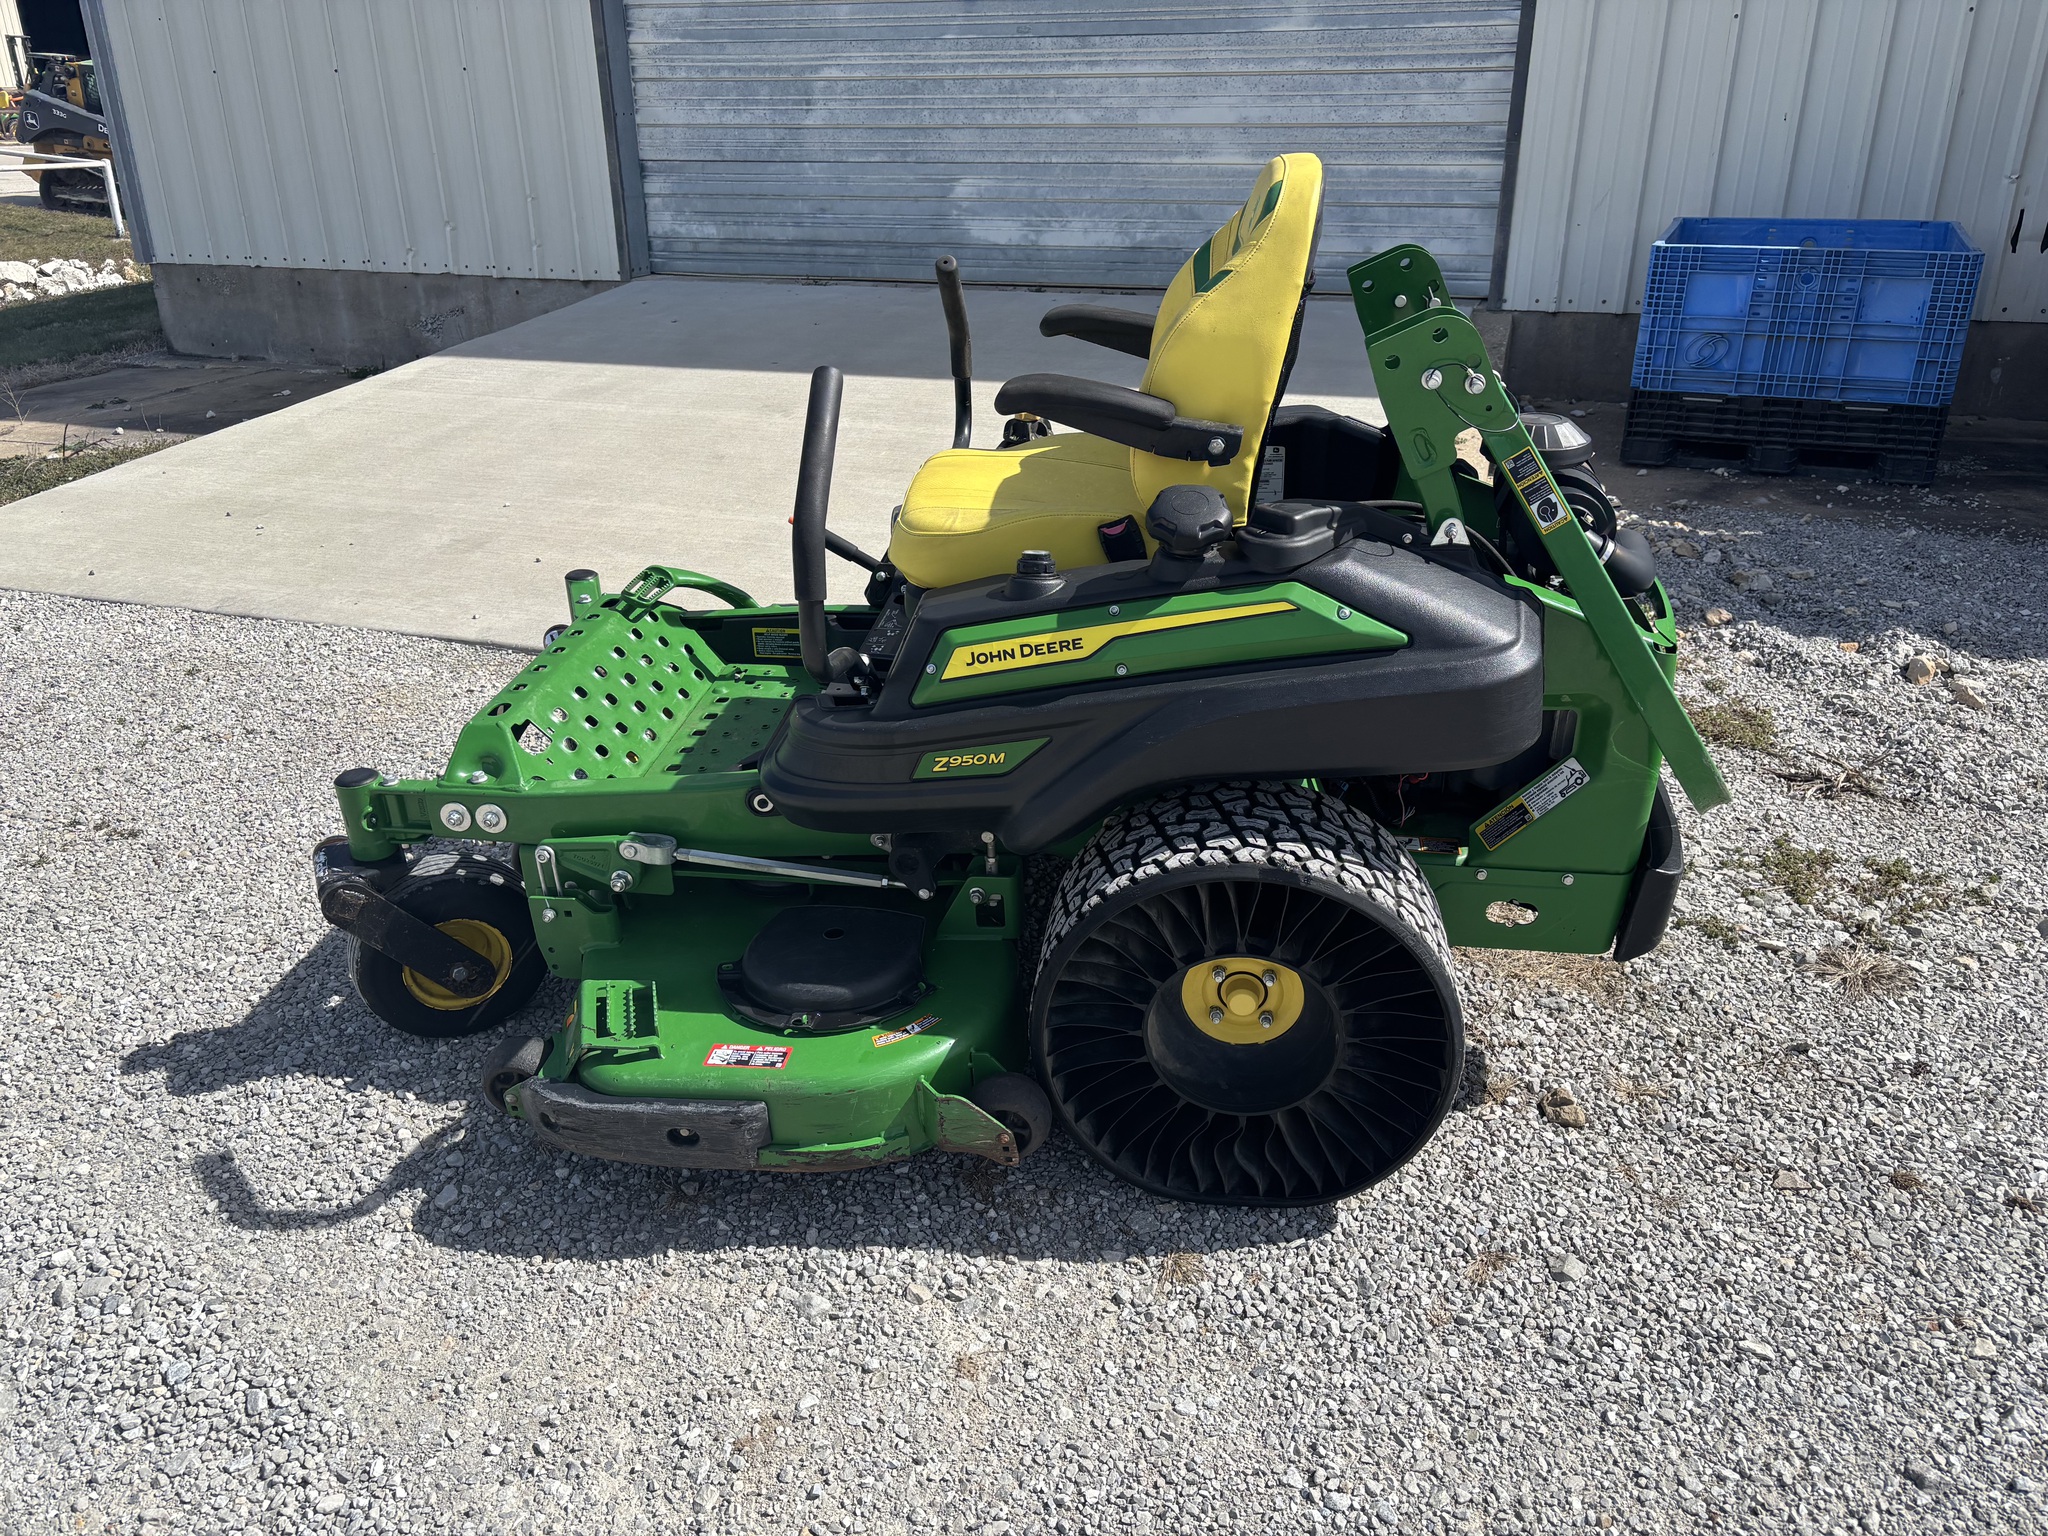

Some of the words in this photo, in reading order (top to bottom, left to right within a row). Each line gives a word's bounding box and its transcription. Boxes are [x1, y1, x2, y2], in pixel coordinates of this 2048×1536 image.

[966, 648, 1016, 667] JOHN
[1019, 637, 1084, 658] DEERE
[932, 752, 1006, 772] Z950M
[1489, 804, 1514, 825] ATENCIÓN
